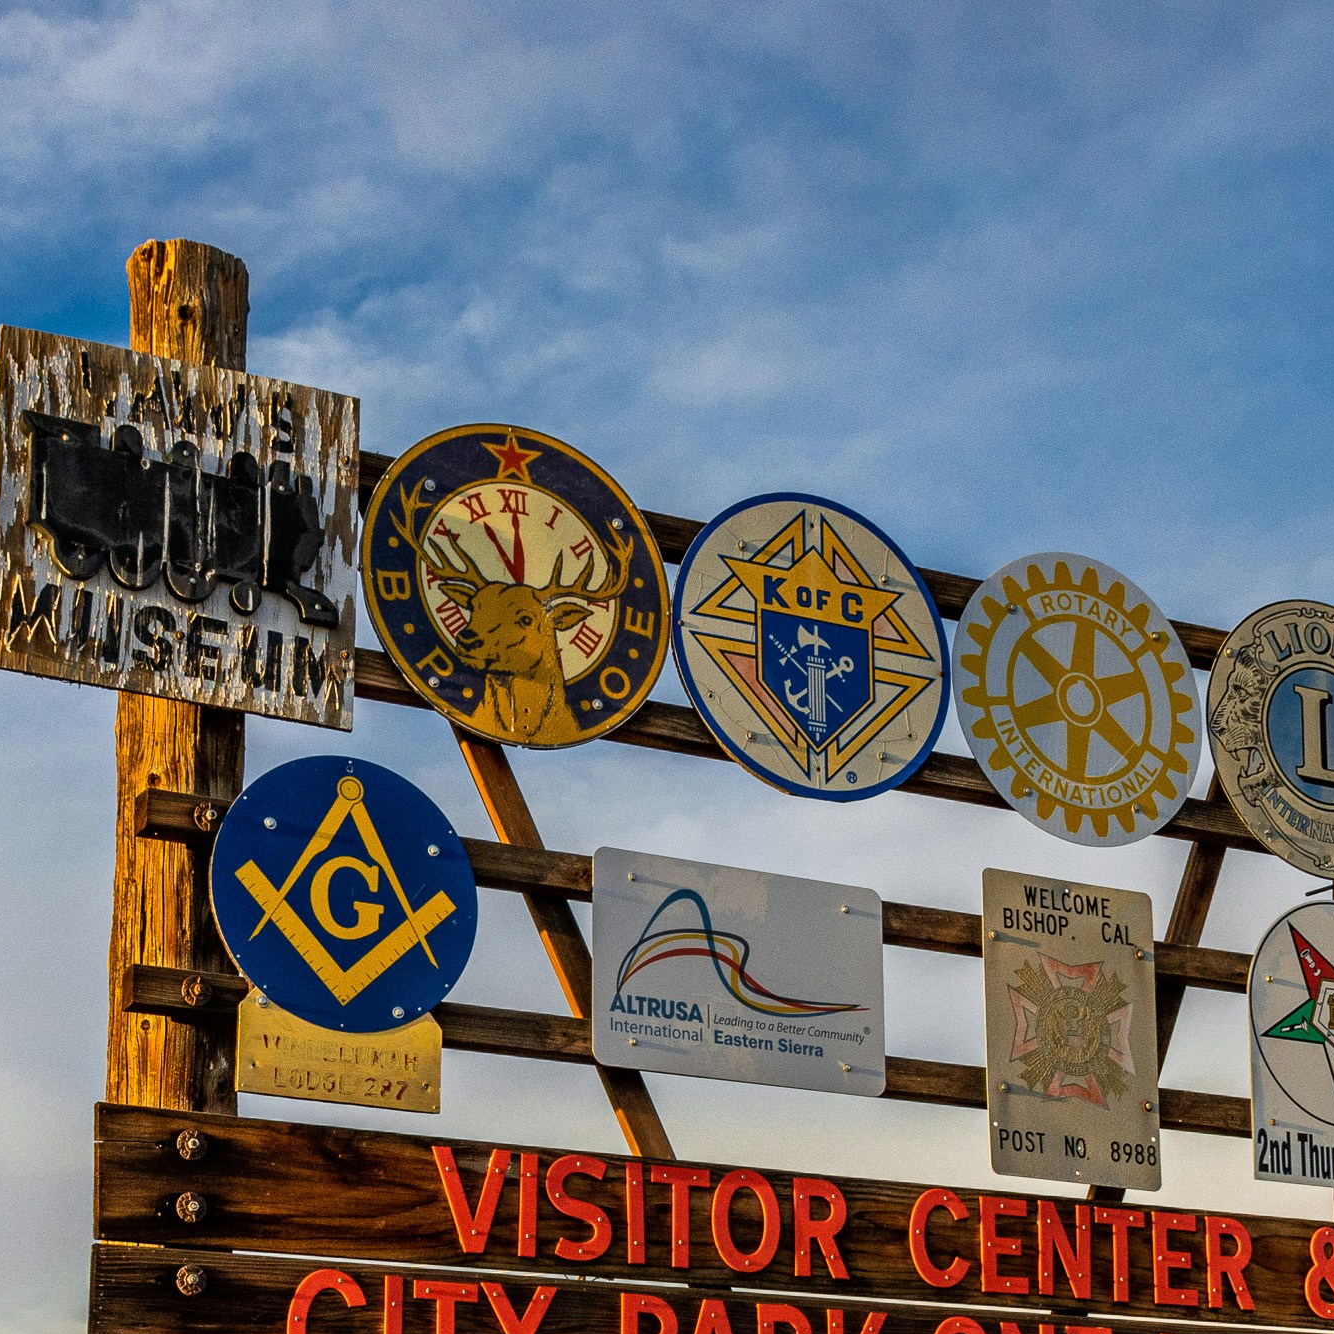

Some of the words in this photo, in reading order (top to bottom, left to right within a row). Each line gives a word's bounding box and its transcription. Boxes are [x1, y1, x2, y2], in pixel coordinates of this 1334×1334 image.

[763, 574, 791, 609] K
[841, 591, 863, 623] C
[1040, 594, 1136, 638] ROTARY
[6, 574, 343, 710] MUSEUM
[997, 719, 1158, 806] INTERNATIONAL
[310, 856, 385, 941] G
[1023, 885, 1111, 919] WELCOME
[609, 993, 704, 1023] ALTRUSA
[713, 1014, 754, 1031] Leading
[756, 1020, 766, 1031] to
[768, 1023, 775, 1032] a
[777, 1022, 807, 1035] Better
[610, 1017, 703, 1042] International
[714, 1030, 774, 1051] Eastern
[777, 1038, 824, 1058] Sierra
[274, 1067, 356, 1096] LODGE
[364, 1077, 409, 1101] 287
[999, 1129, 1046, 1153] POST
[1111, 1141, 1157, 1166] 8988
[1257, 1128, 1292, 1176] 2nd
[431, 1145, 850, 1280] VISITOR
[908, 1187, 1256, 1312] CENTER
